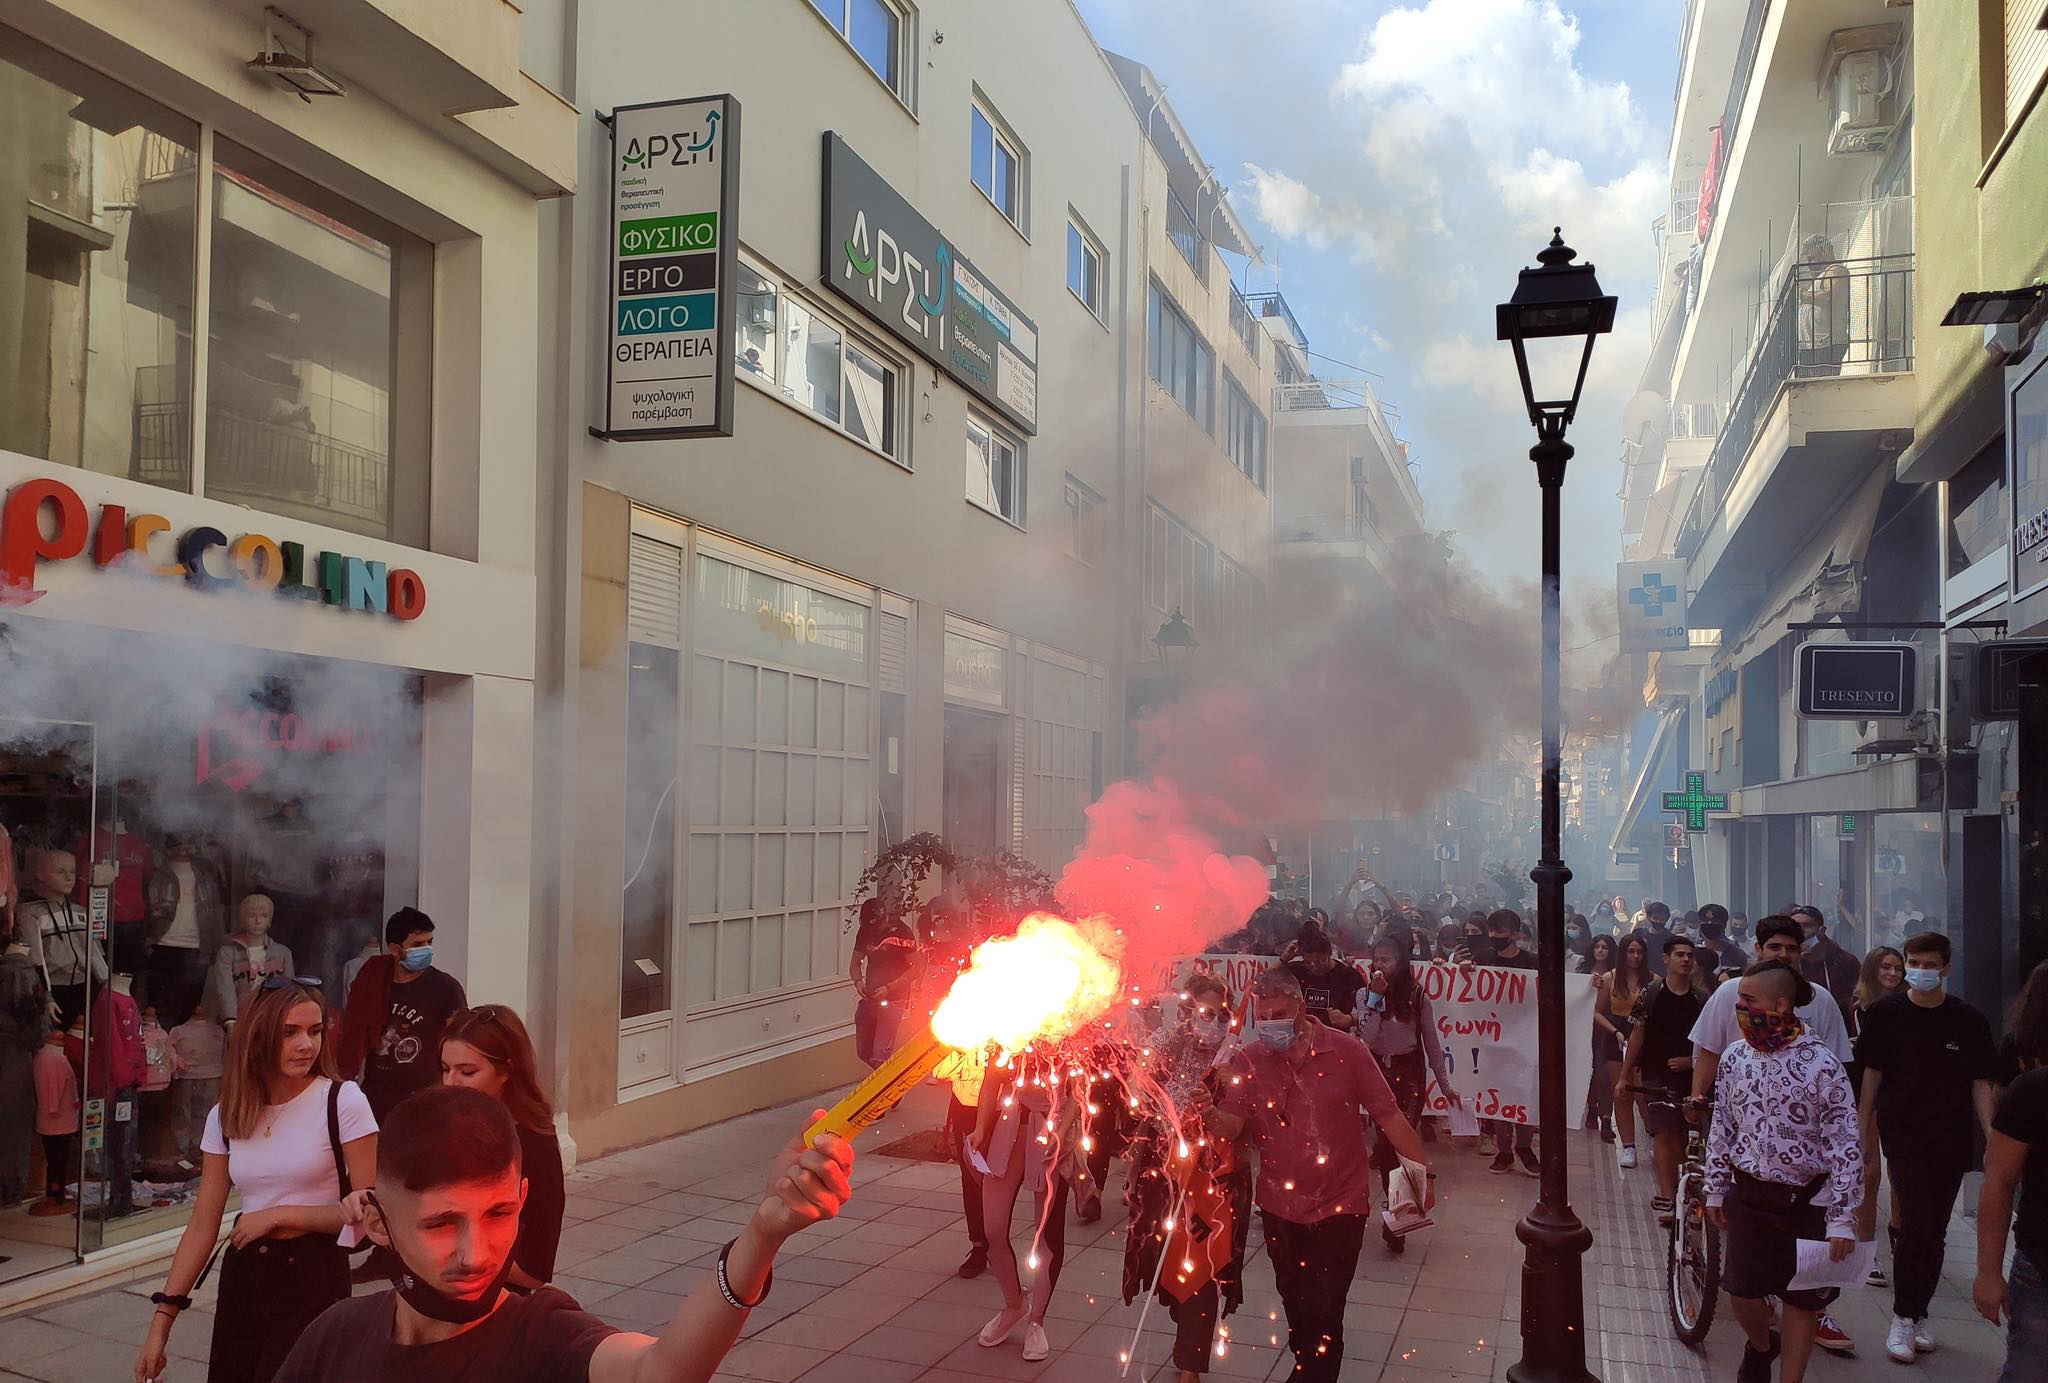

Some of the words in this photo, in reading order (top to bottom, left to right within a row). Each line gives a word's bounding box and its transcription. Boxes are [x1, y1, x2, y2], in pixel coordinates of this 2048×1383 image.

[620, 187, 664, 199] θεραπευτική
[622, 223, 714, 251] ΦΥΣΙΚΟ
[623, 265, 684, 291] ΕΡΓΟ
[620, 305, 690, 332] ΛΟΓΟ
[616, 337, 714, 363] ΘΕΡΑΠΕΙΑ
[632, 388, 695, 407] ψυχολογική
[632, 405, 693, 422] παρέμβαση
[1819, 690, 1895, 702] TRESENTO
